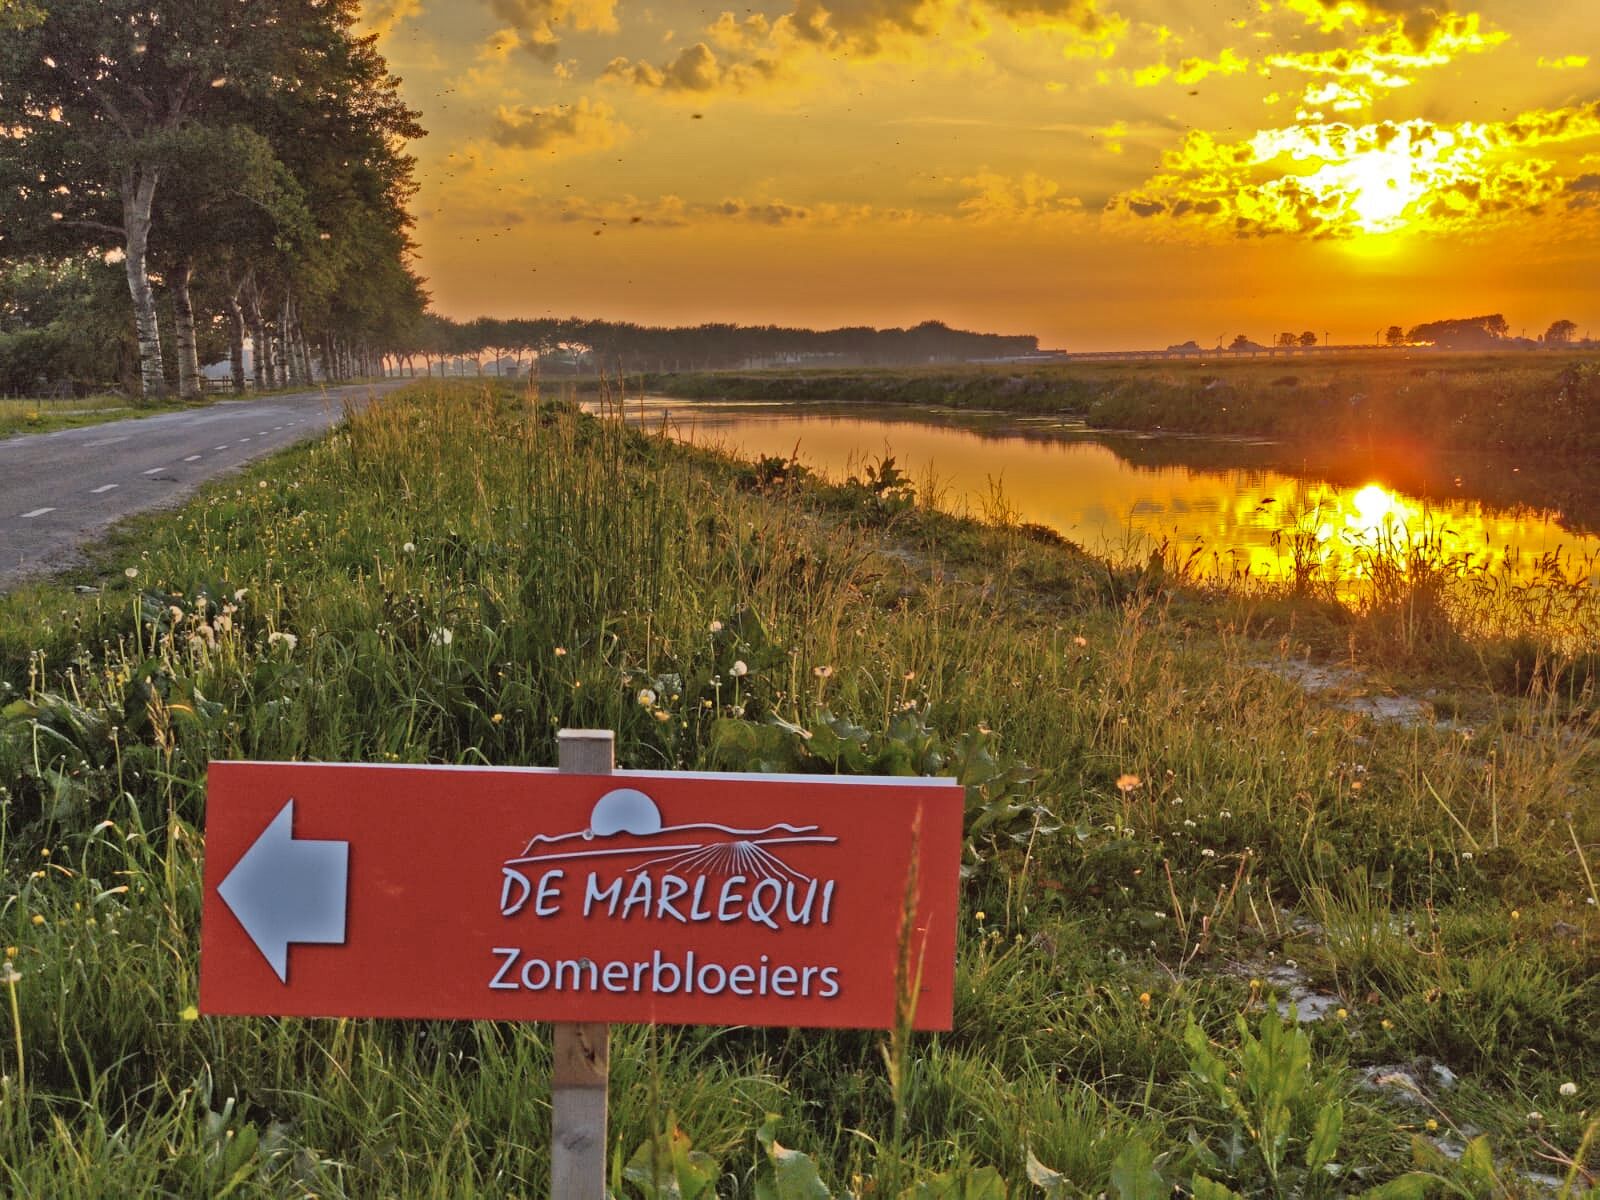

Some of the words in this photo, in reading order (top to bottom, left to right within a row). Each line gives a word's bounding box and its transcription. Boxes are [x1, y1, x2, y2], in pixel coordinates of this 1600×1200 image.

[500, 867, 564, 917] DE
[583, 870, 835, 929] MARLEQUI
[488, 947, 840, 997] Zomerbloeiers
